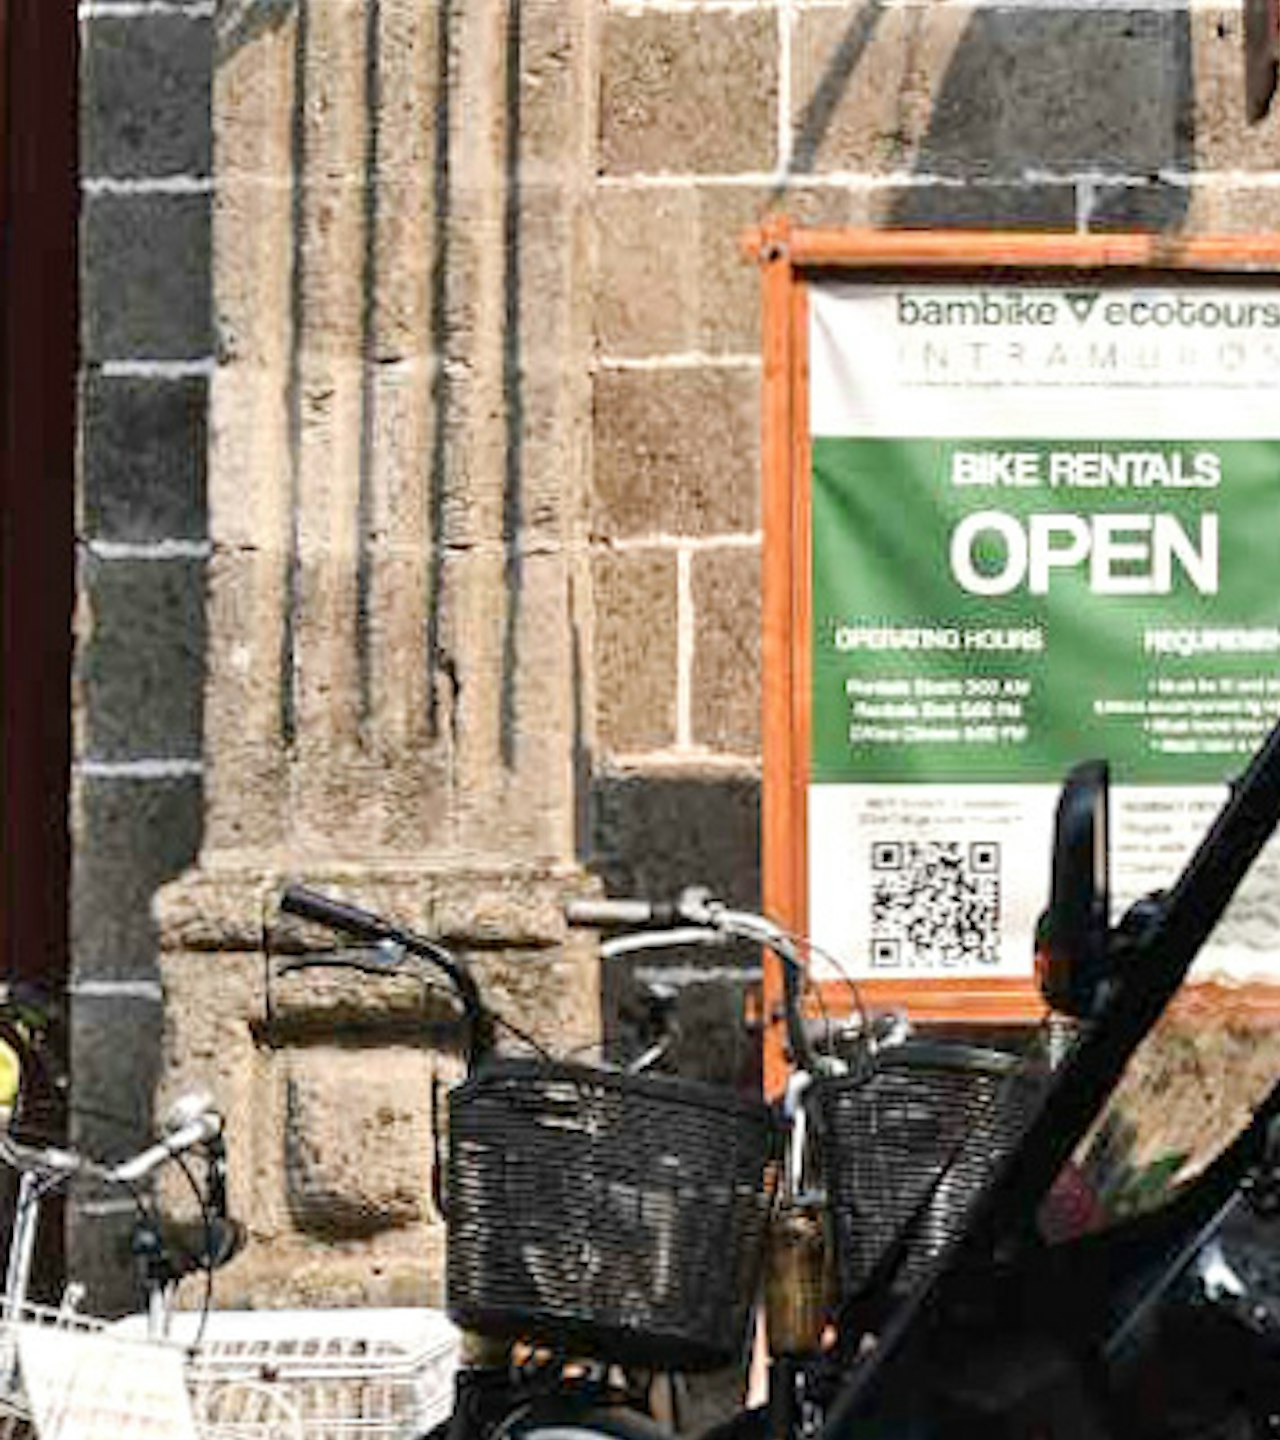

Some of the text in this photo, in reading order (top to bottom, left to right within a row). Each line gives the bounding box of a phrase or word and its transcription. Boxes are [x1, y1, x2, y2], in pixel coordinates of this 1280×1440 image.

[897, 292, 1058, 327] bambike
[951, 451, 1222, 488] BIKE RENTALS
[949, 510, 1220, 596] OPEN
[836, 627, 1045, 652] OPERATING HOURS
